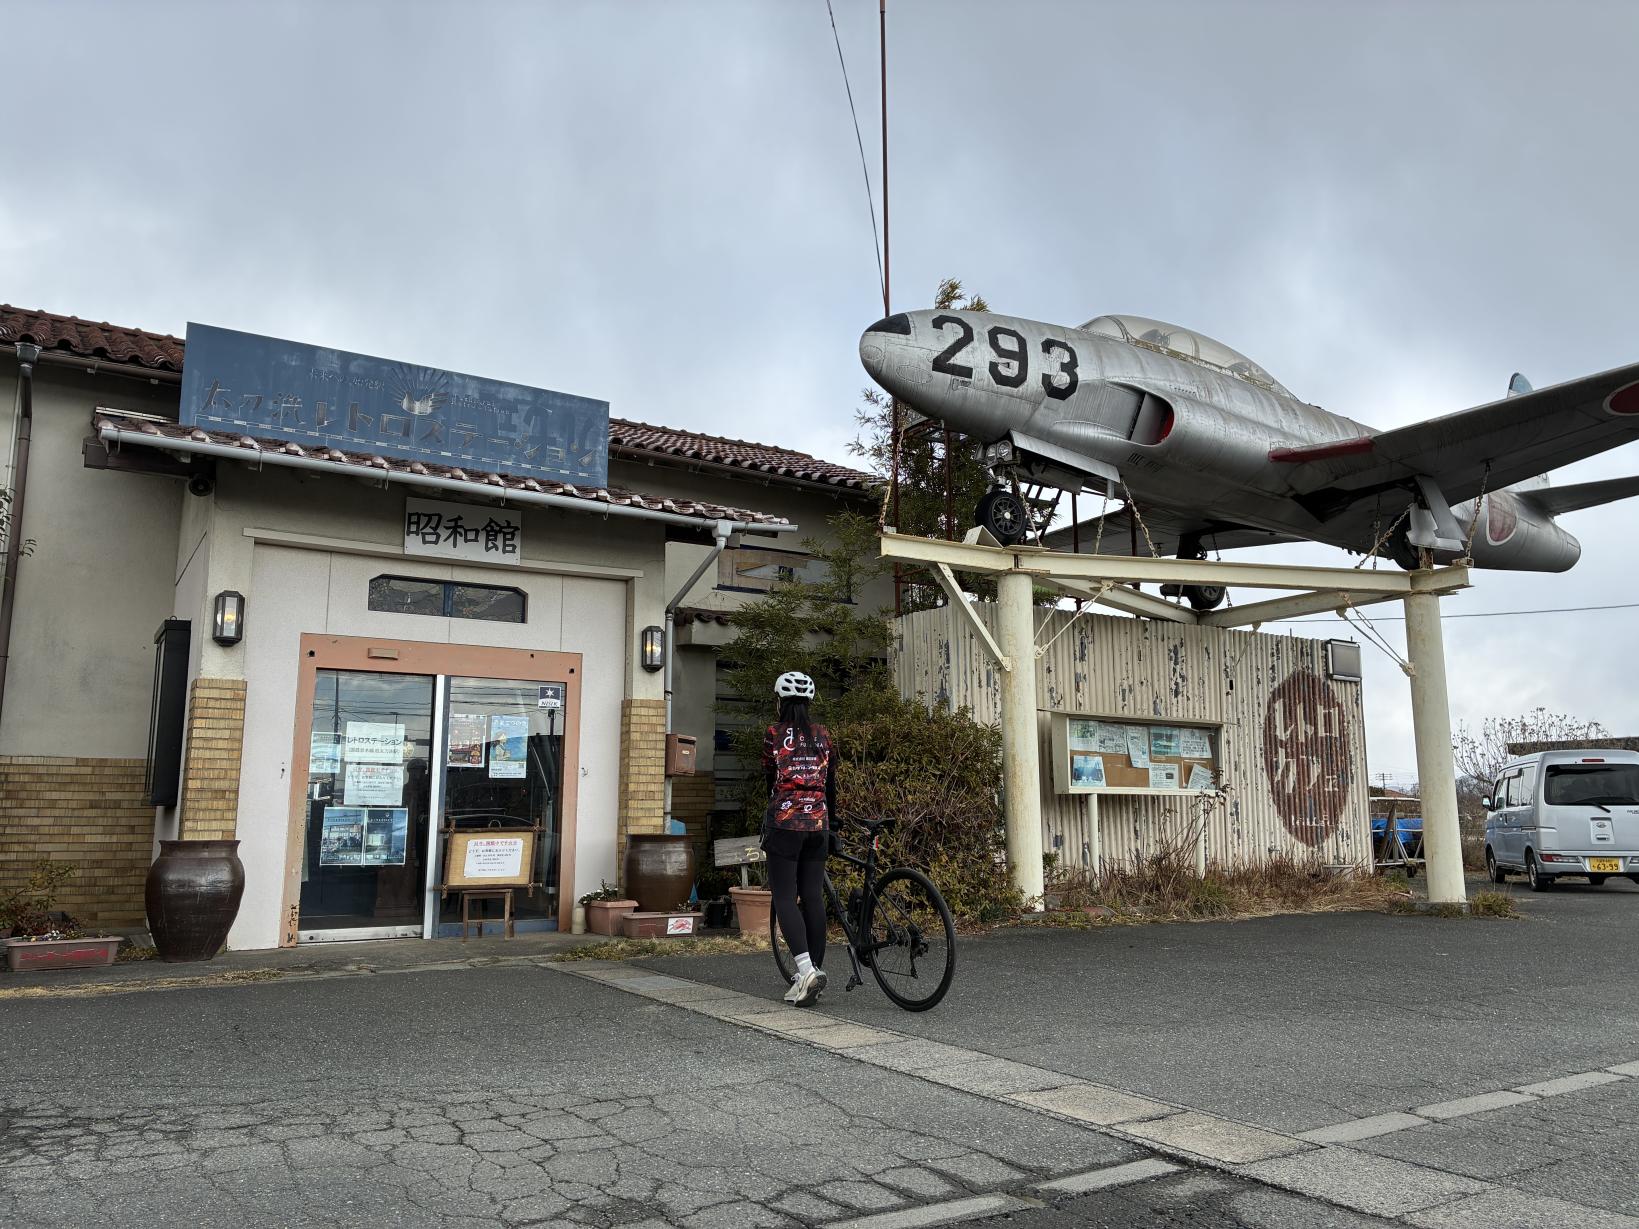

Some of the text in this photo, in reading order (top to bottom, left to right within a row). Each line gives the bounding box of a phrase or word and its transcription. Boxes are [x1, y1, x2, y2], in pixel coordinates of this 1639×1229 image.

[932, 314, 1079, 401] 293
[406, 511, 521, 554] 昭和館
[1275, 699, 1339, 740] レトロ
[347, 736, 402, 746] レトロステーション
